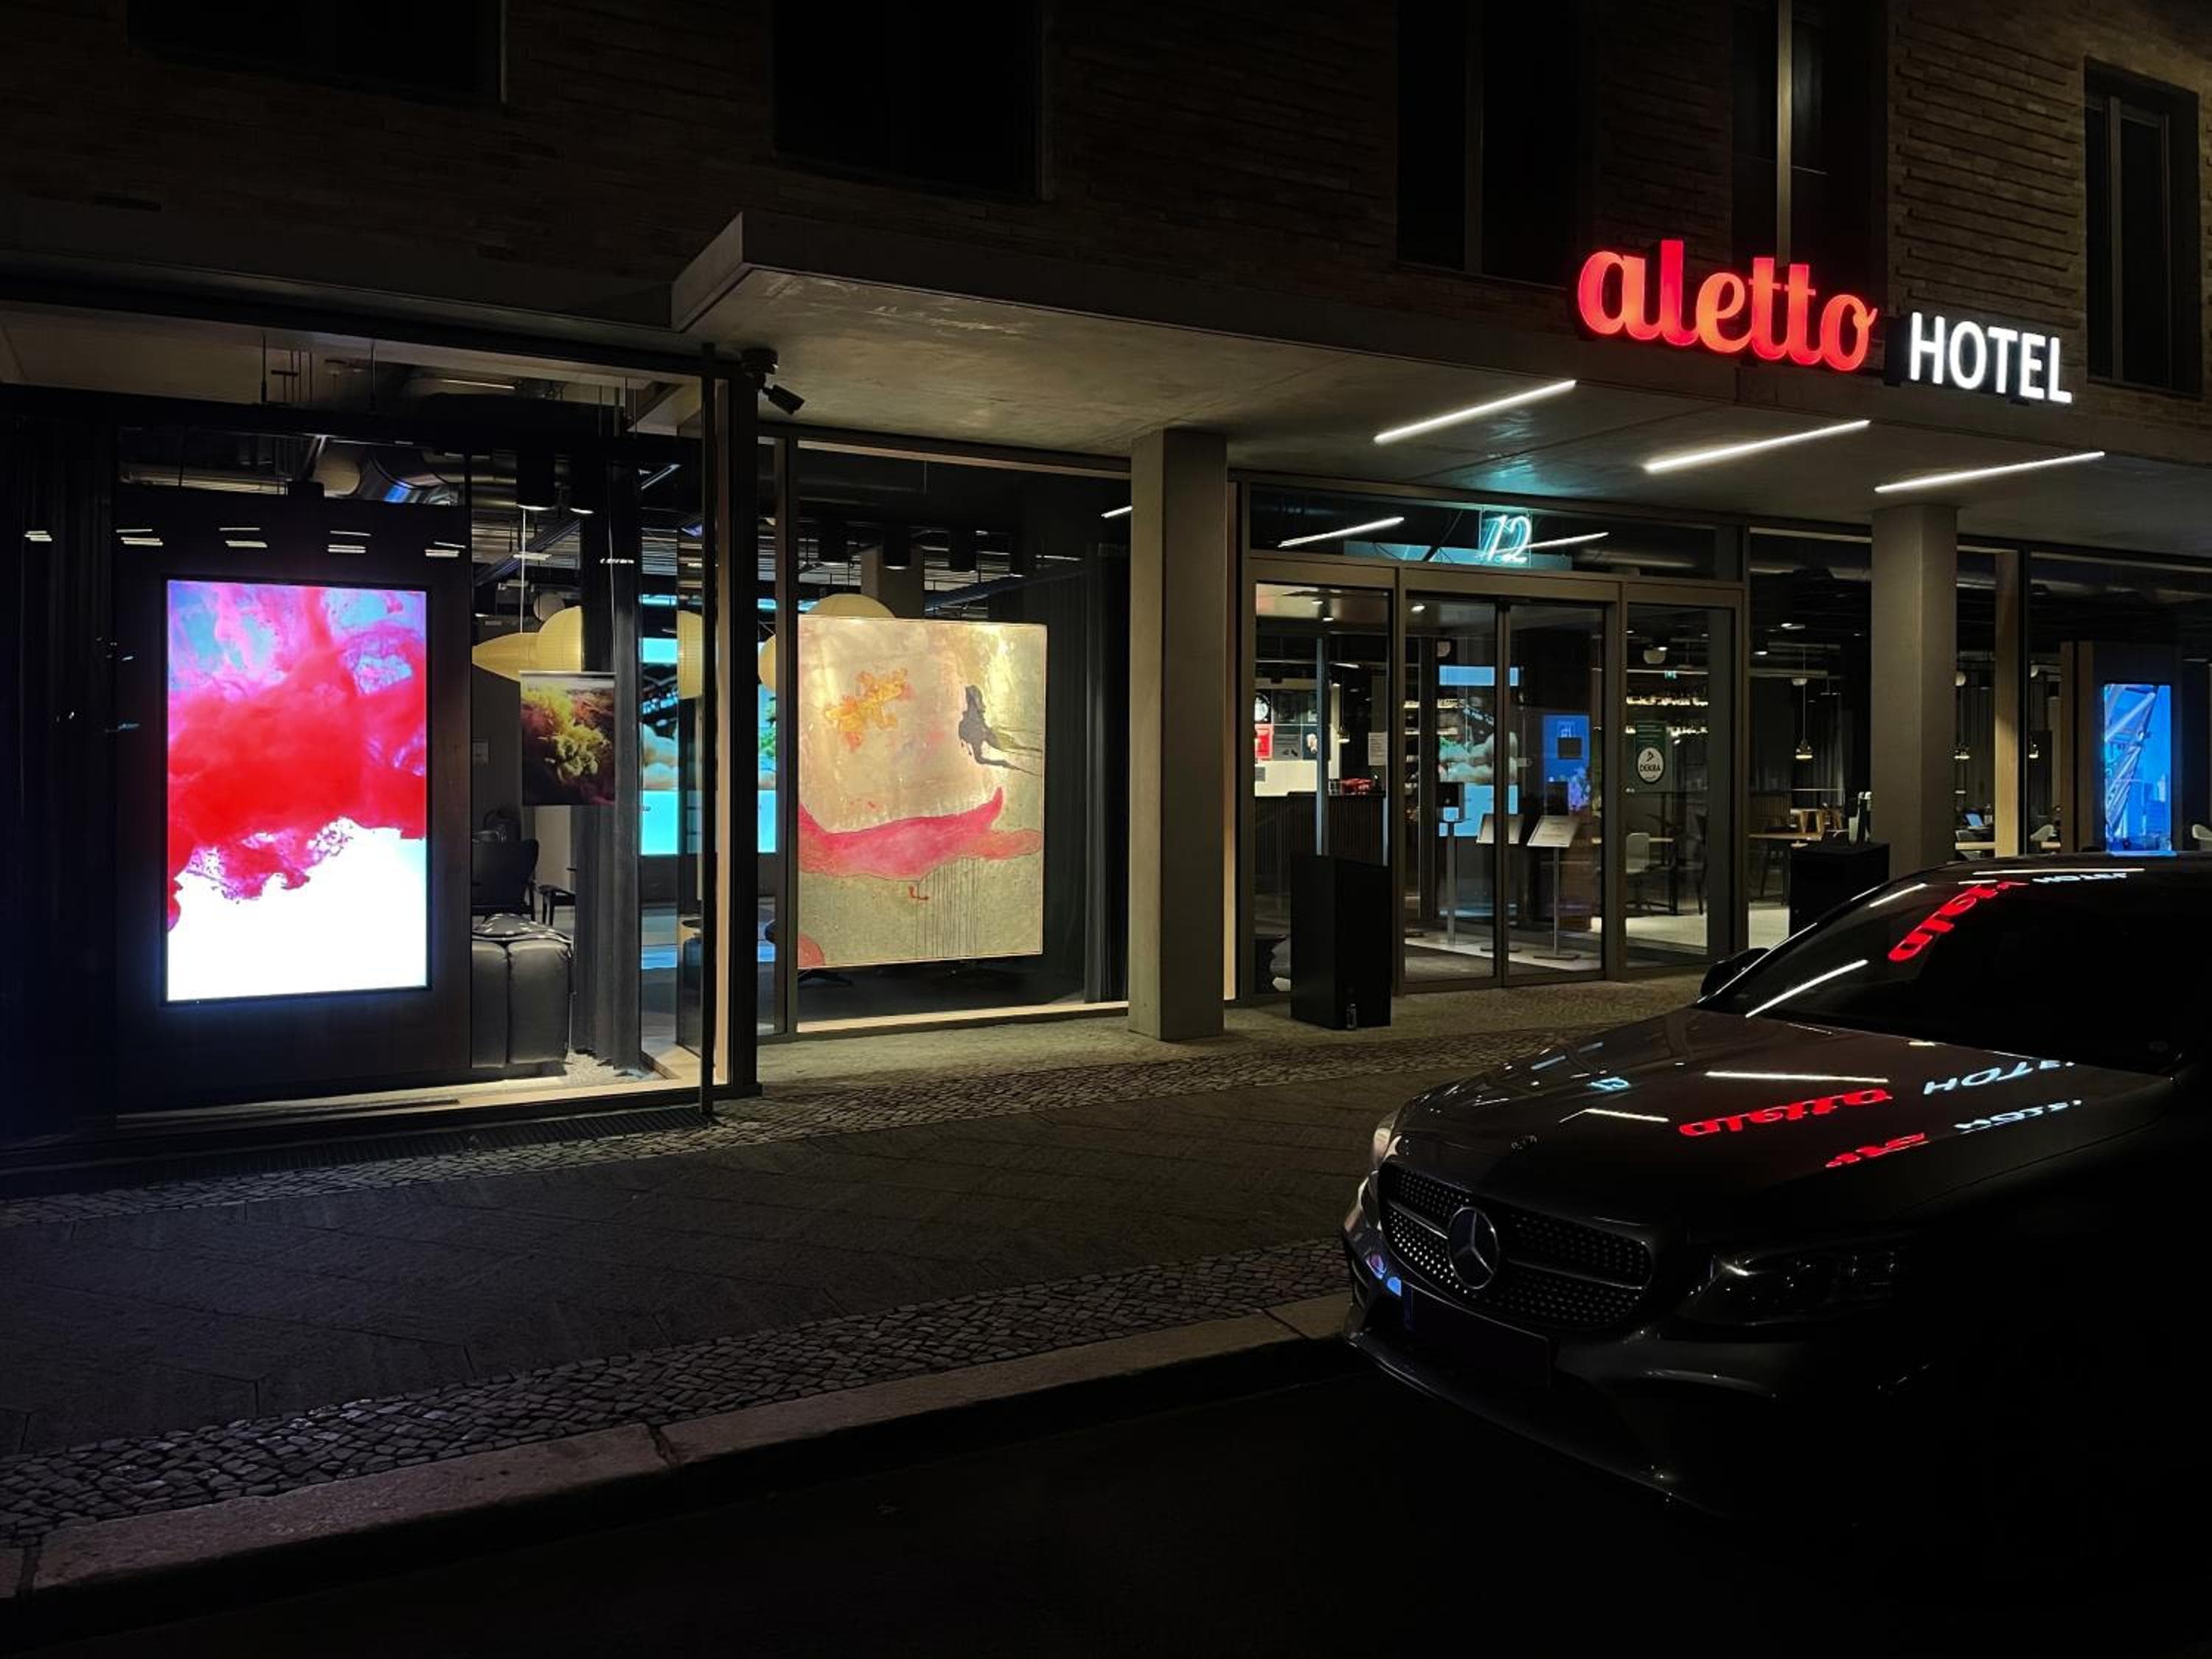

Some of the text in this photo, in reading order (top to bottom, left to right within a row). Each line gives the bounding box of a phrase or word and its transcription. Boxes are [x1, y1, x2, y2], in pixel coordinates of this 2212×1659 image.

[1577, 239, 2073, 404] aletto HOTEL
[1486, 514, 1531, 563] 12
